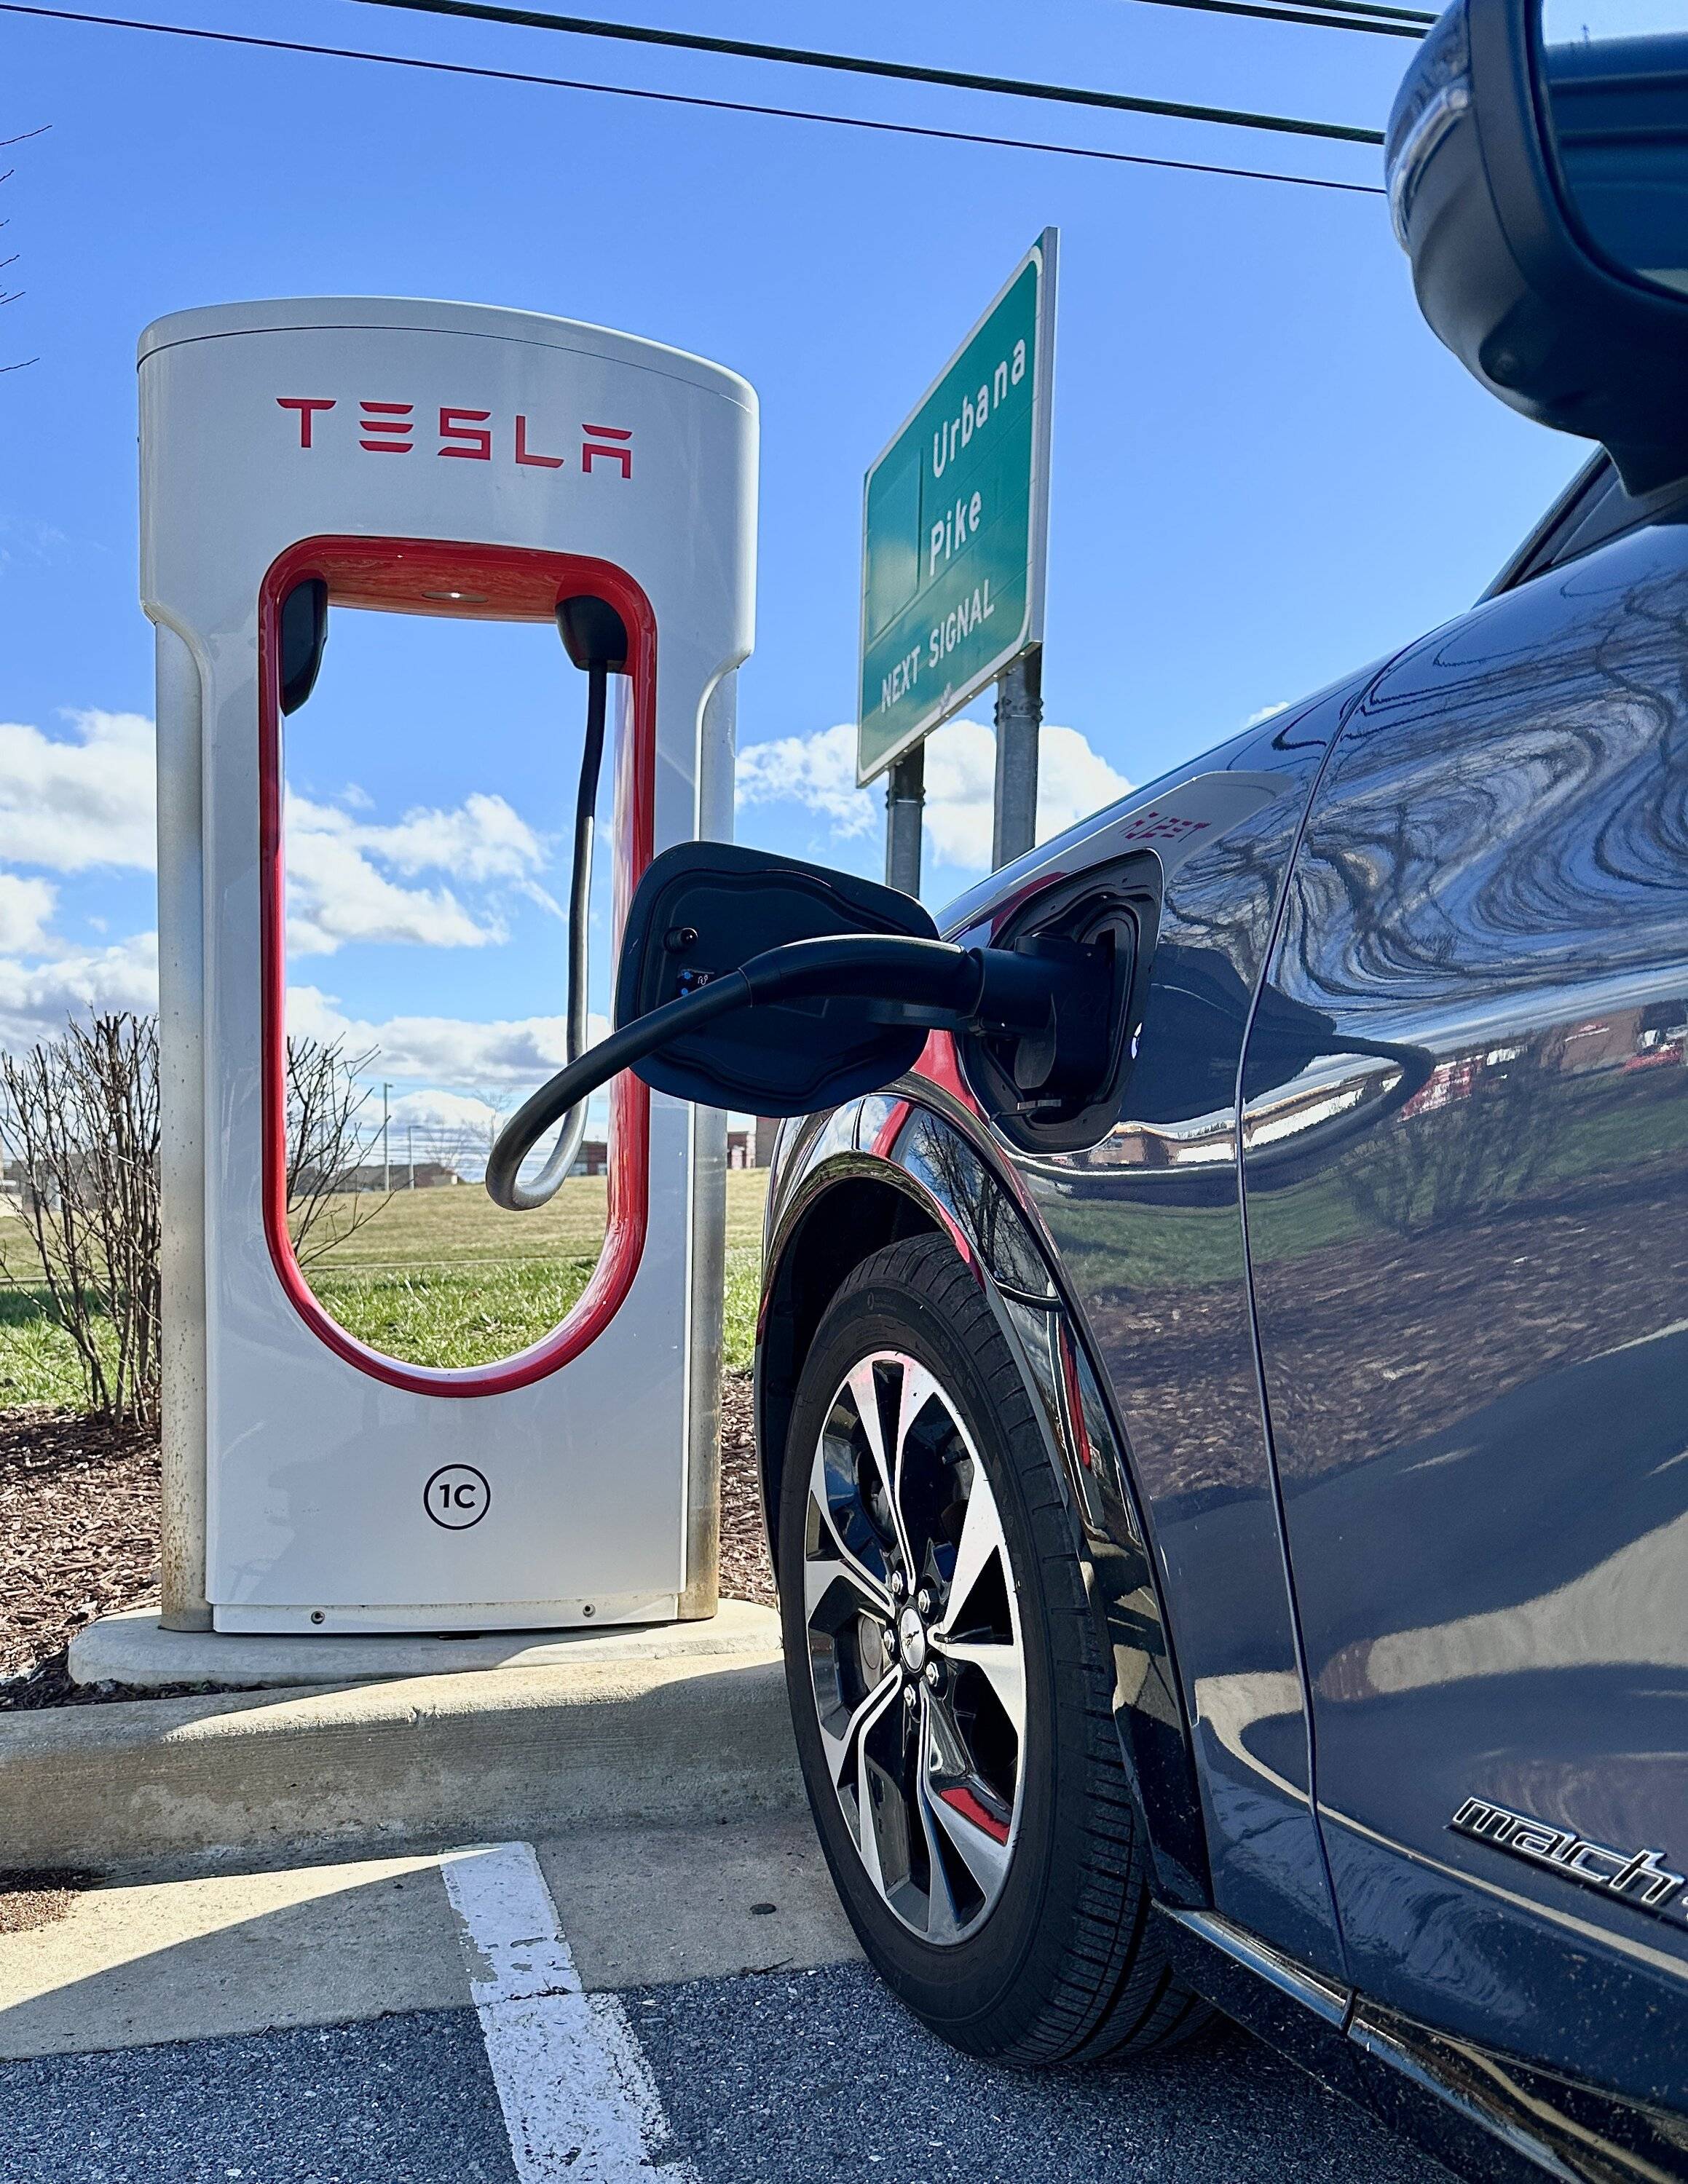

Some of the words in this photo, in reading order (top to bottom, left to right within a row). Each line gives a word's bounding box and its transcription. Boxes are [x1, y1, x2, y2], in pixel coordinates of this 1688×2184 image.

[276, 397, 632, 479] TESLA
[933, 339, 1026, 478] Urbana
[929, 491, 982, 577] Pike
[881, 645, 921, 713] NEXT
[929, 579, 995, 668] SIGNAL
[439, 1484, 476, 1508] 1C
[1452, 1797, 1688, 1922] mach
